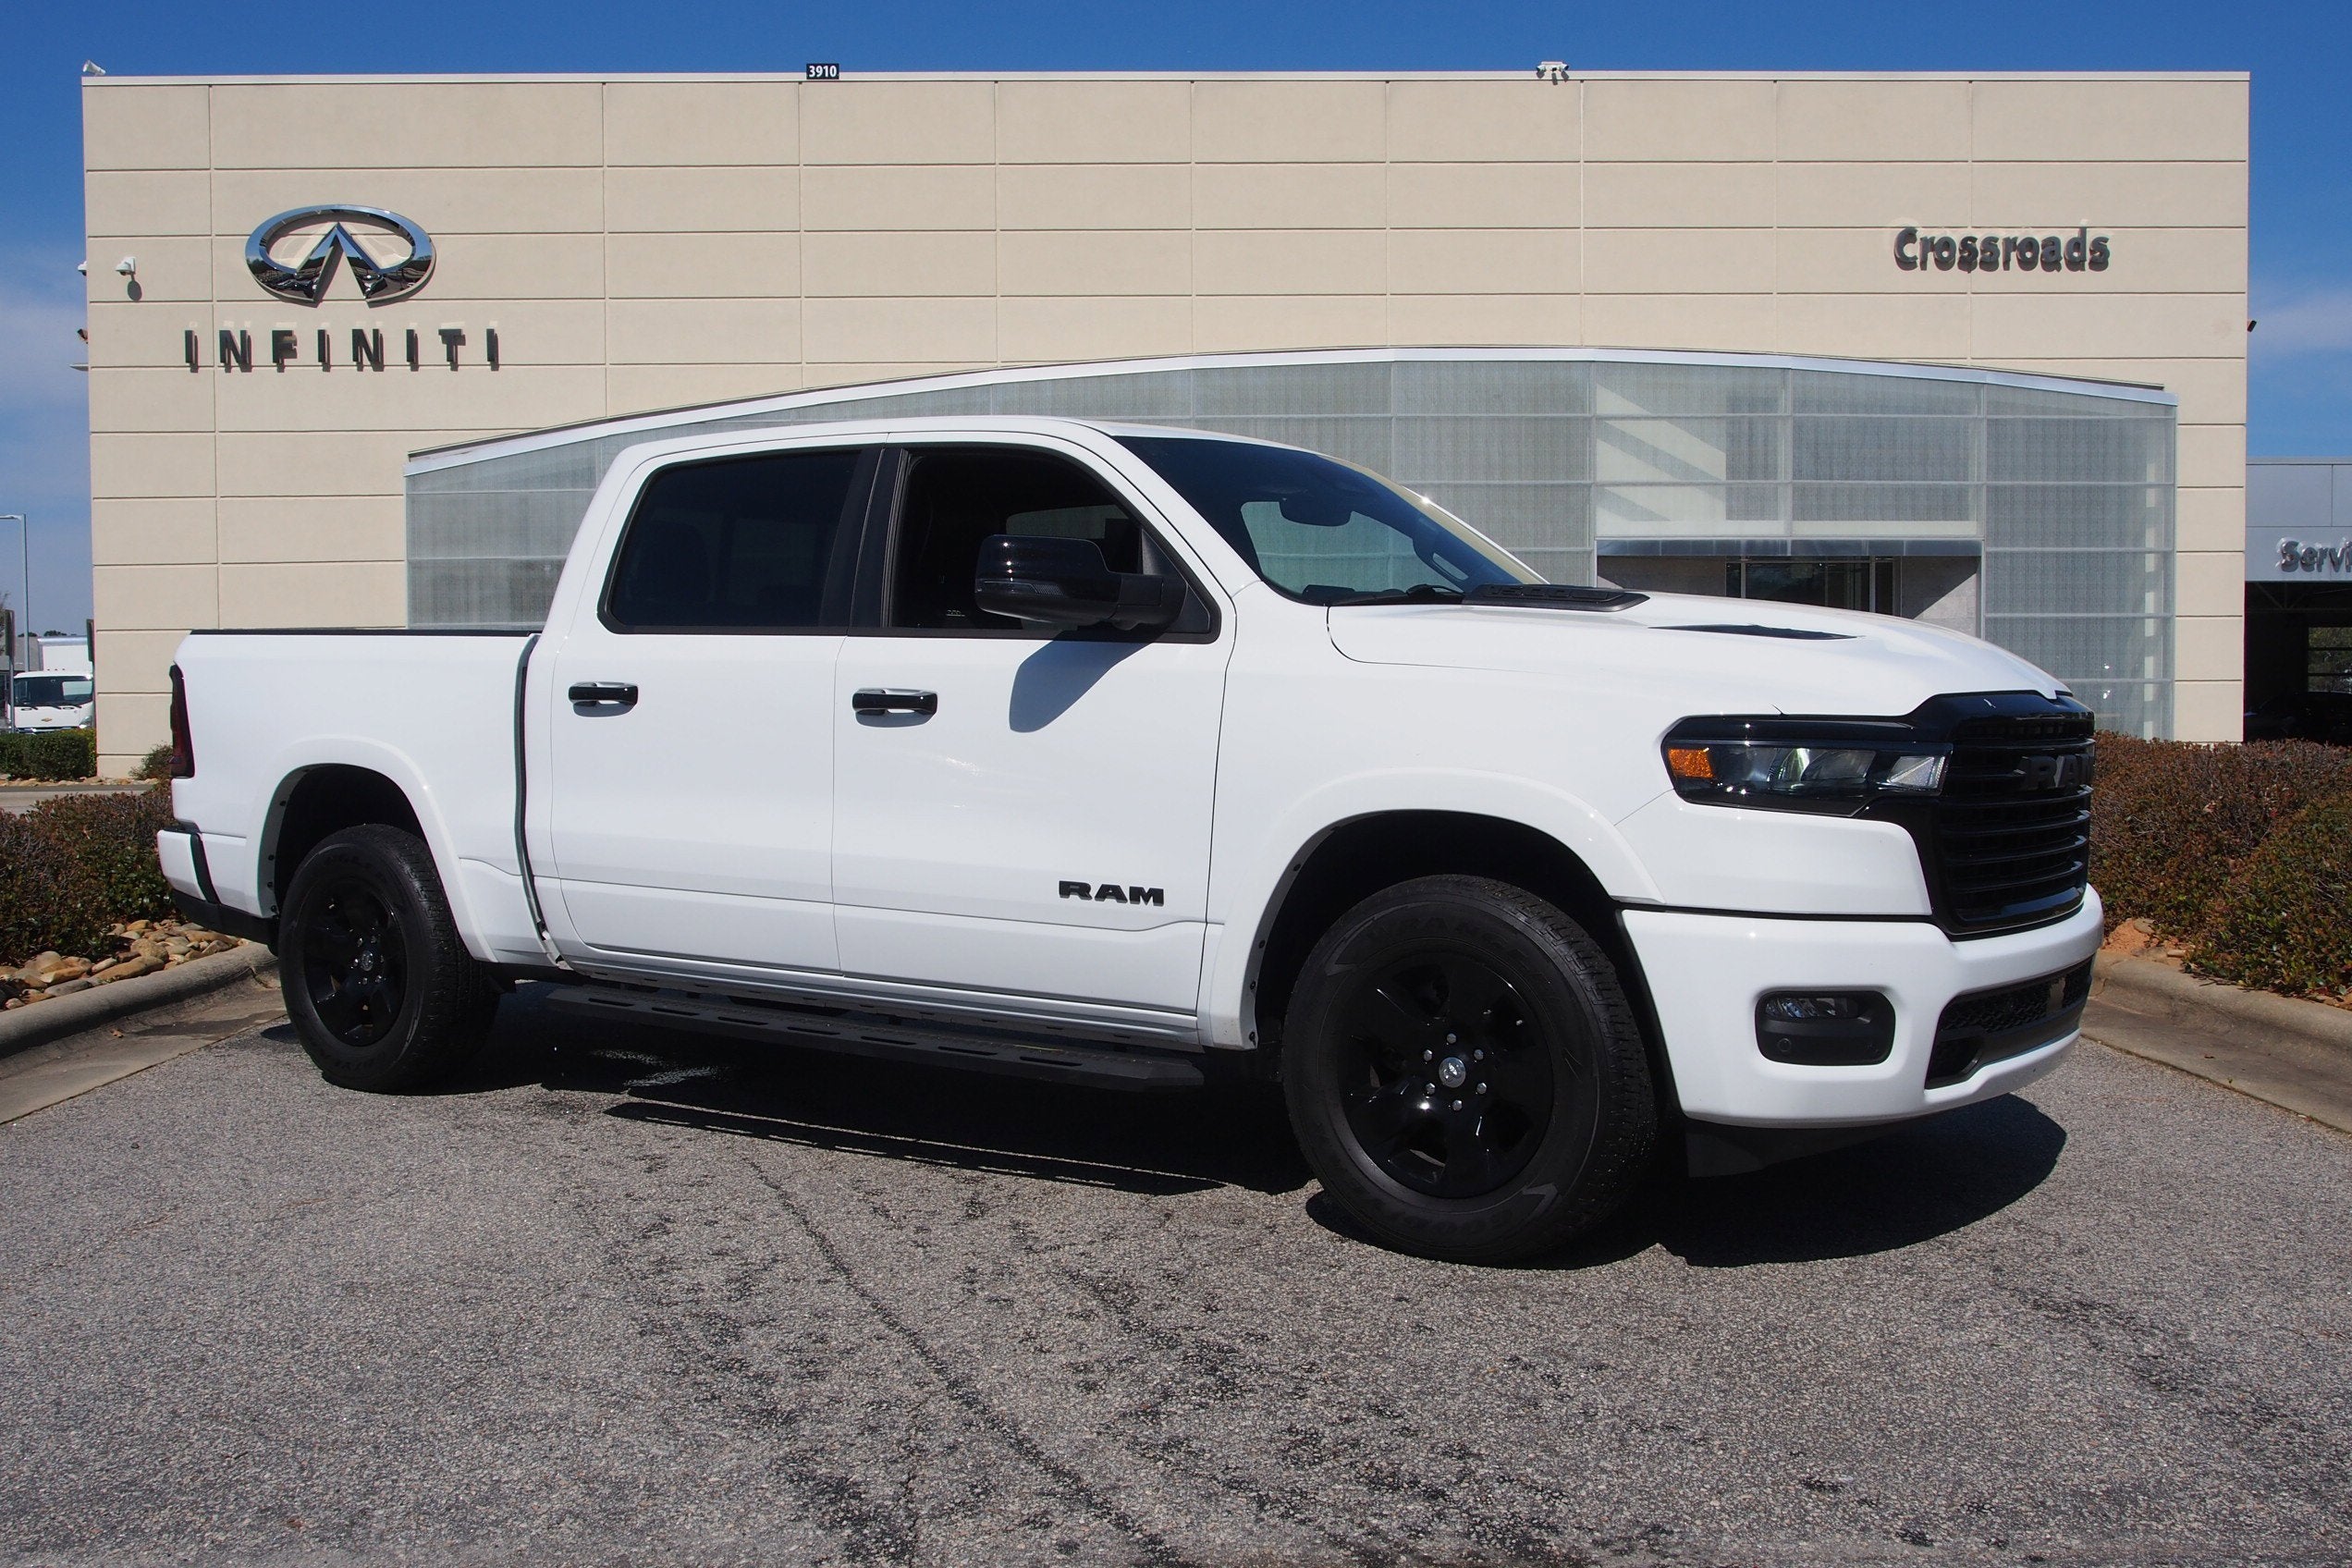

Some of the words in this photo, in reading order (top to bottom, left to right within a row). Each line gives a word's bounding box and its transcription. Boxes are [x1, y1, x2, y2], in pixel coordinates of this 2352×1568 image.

[808, 65, 838, 78] 3910
[1893, 226, 2111, 273] Crossroads
[184, 327, 500, 372] INFINITI
[1058, 879, 1165, 907] RAM
